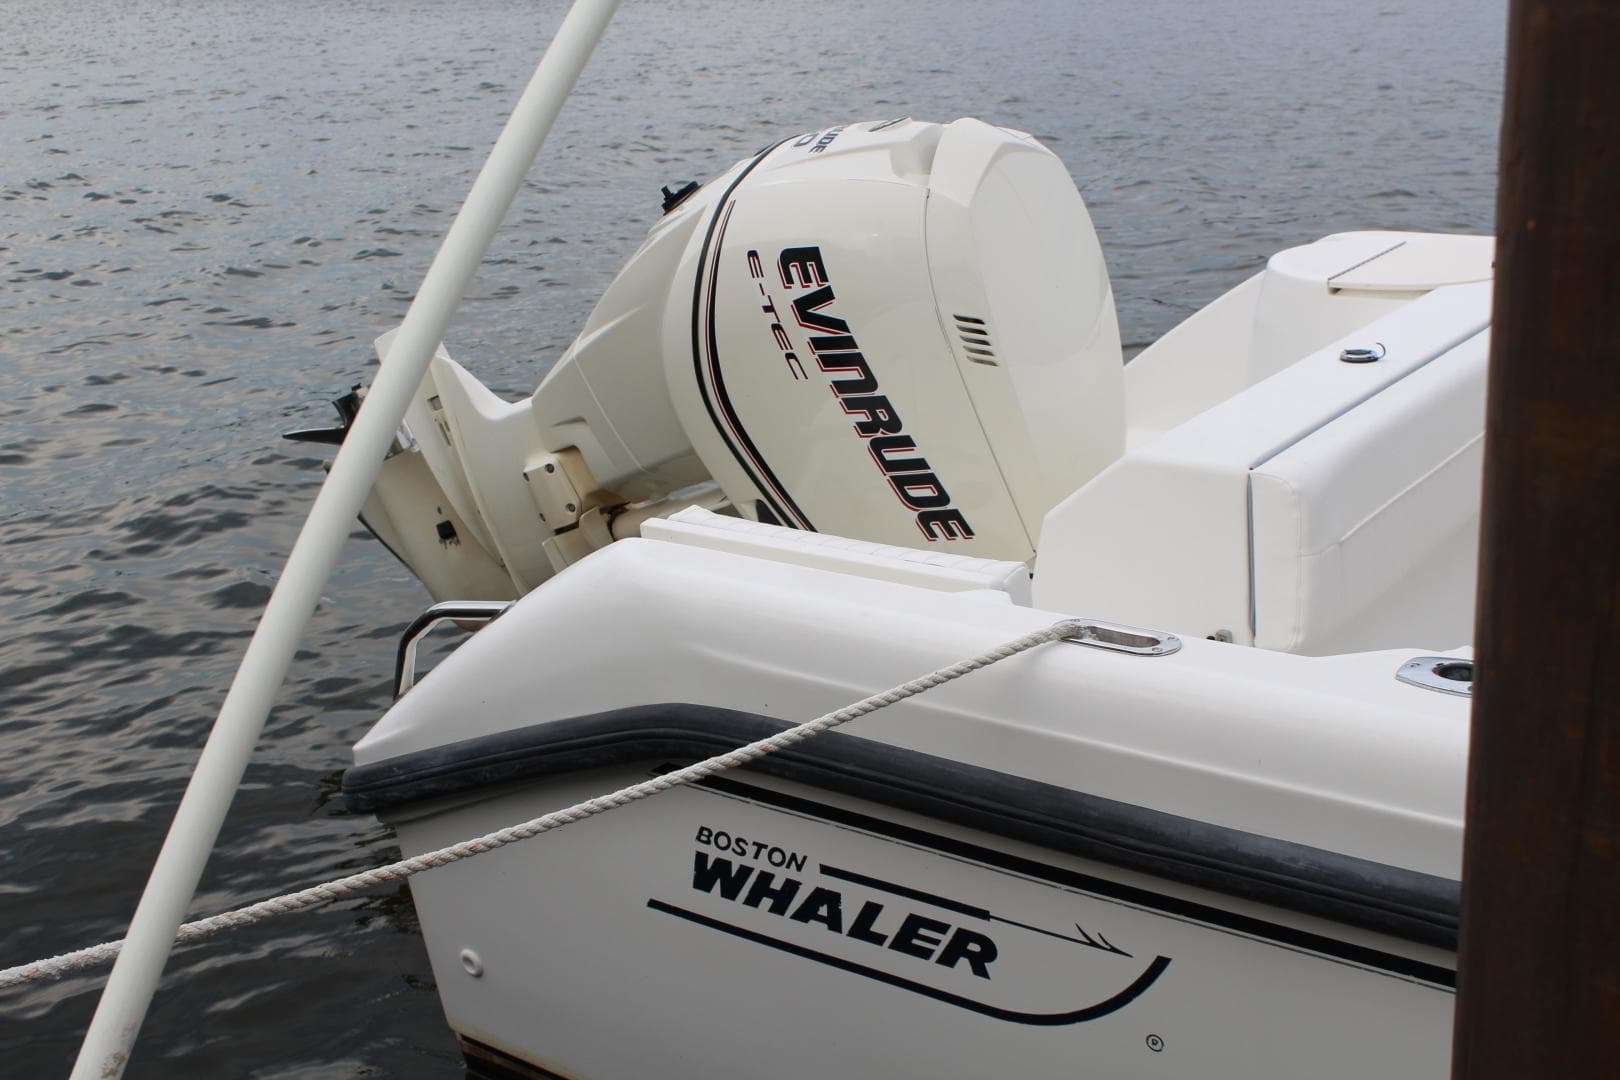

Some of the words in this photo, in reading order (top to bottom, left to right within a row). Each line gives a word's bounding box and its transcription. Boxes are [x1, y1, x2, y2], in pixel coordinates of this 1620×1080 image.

[746, 249, 809, 381] E-TEC
[776, 245, 976, 542] EVINRUDE
[695, 825, 808, 873] BOSTON
[692, 850, 999, 980] WHALER
